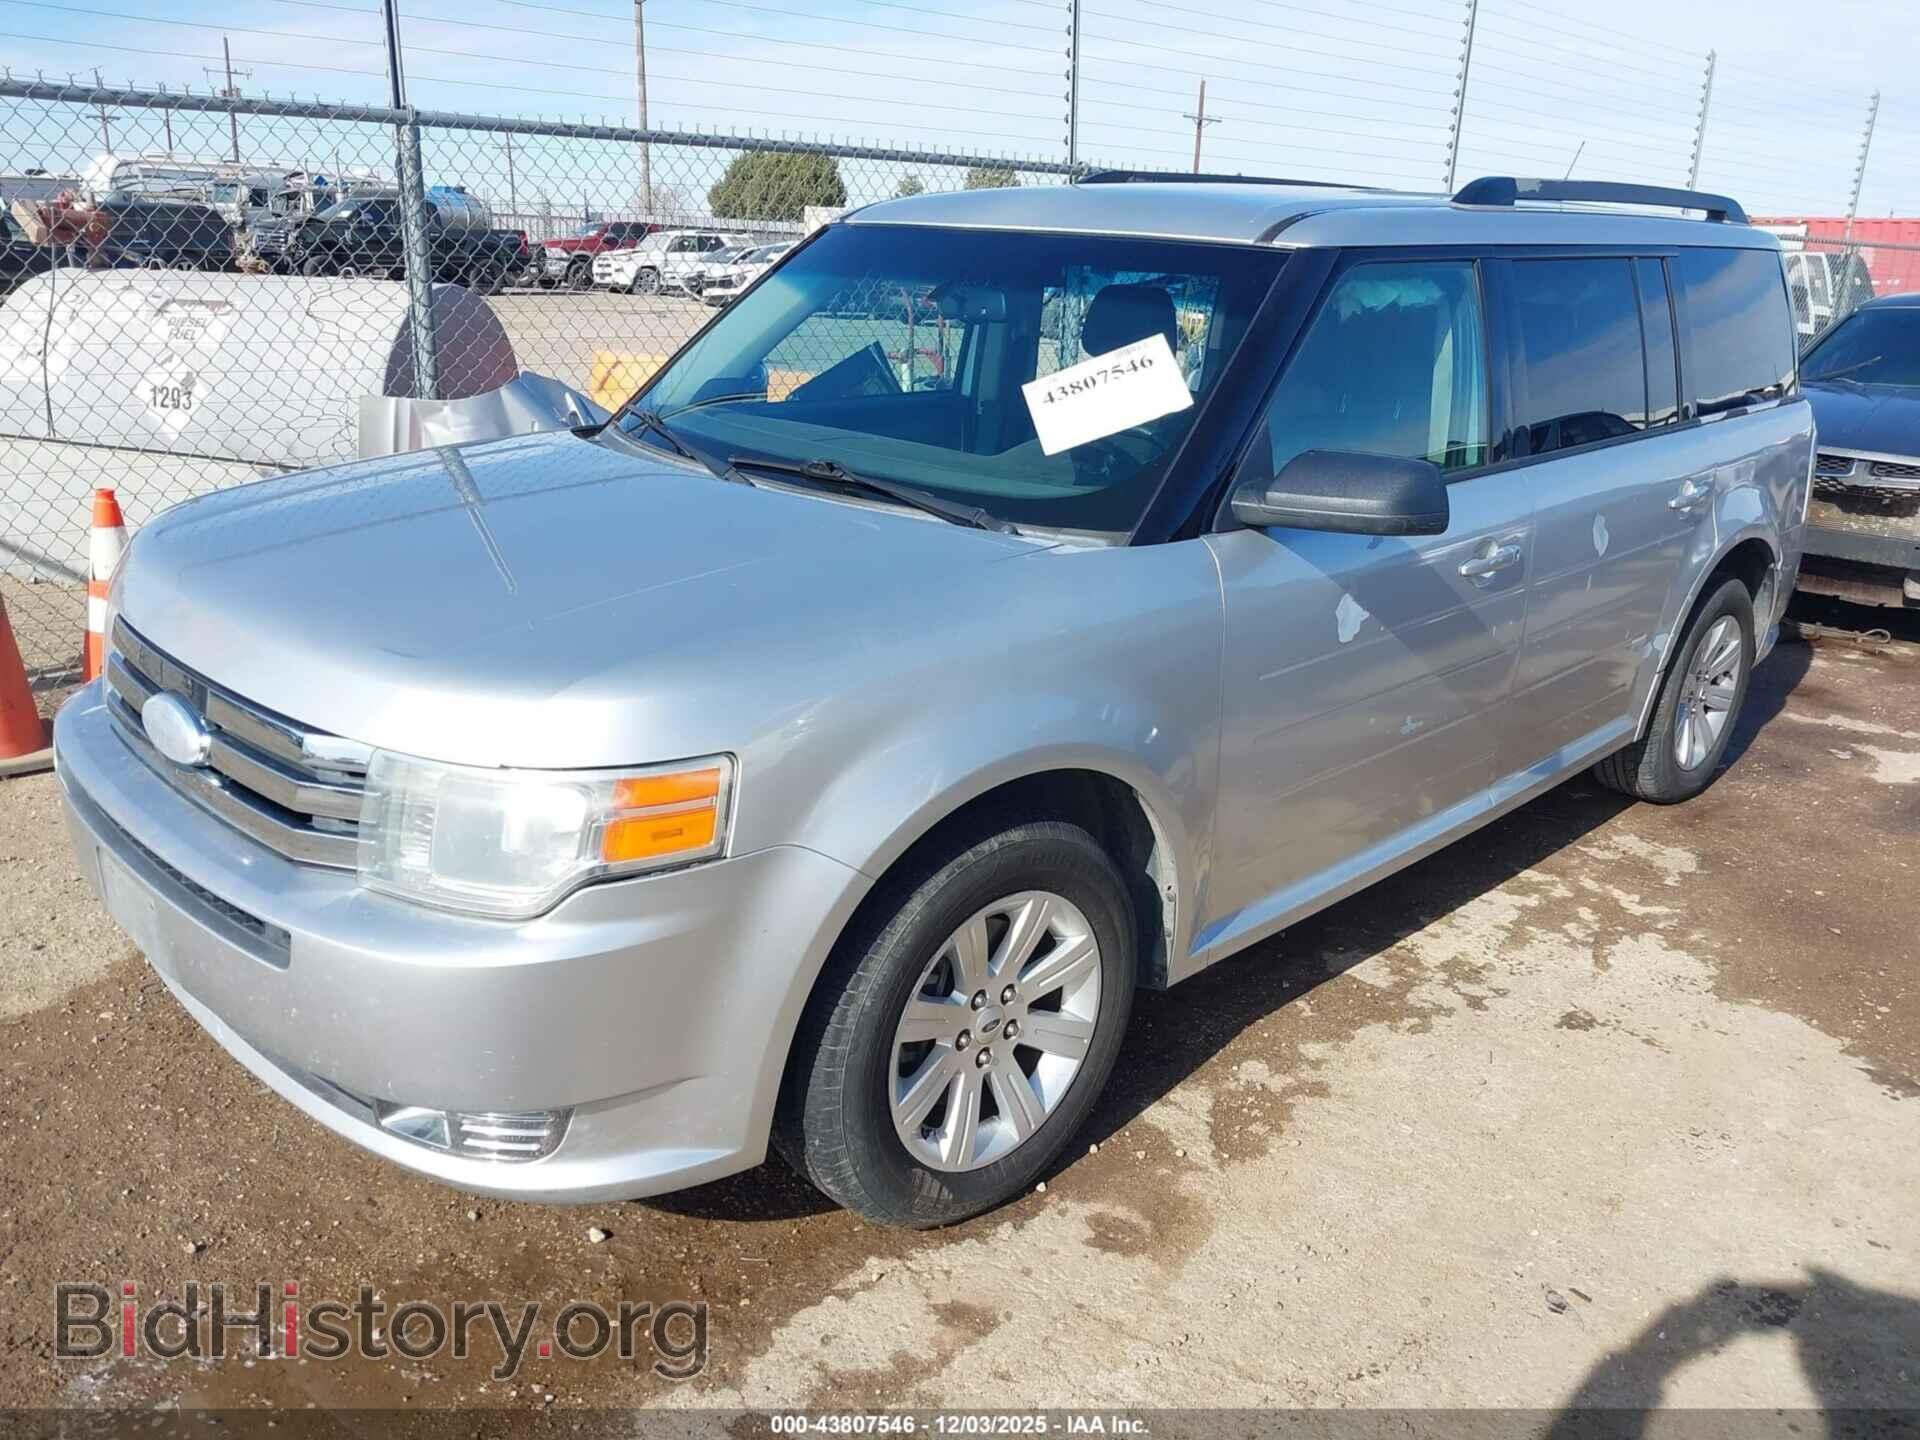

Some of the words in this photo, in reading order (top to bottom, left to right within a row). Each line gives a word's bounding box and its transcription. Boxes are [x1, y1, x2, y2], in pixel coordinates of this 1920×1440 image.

[168, 316, 207, 328] DIESEL
[168, 328, 196, 340] FUEL
[1042, 355, 1153, 404] 43807546
[150, 385, 192, 410] 1293
